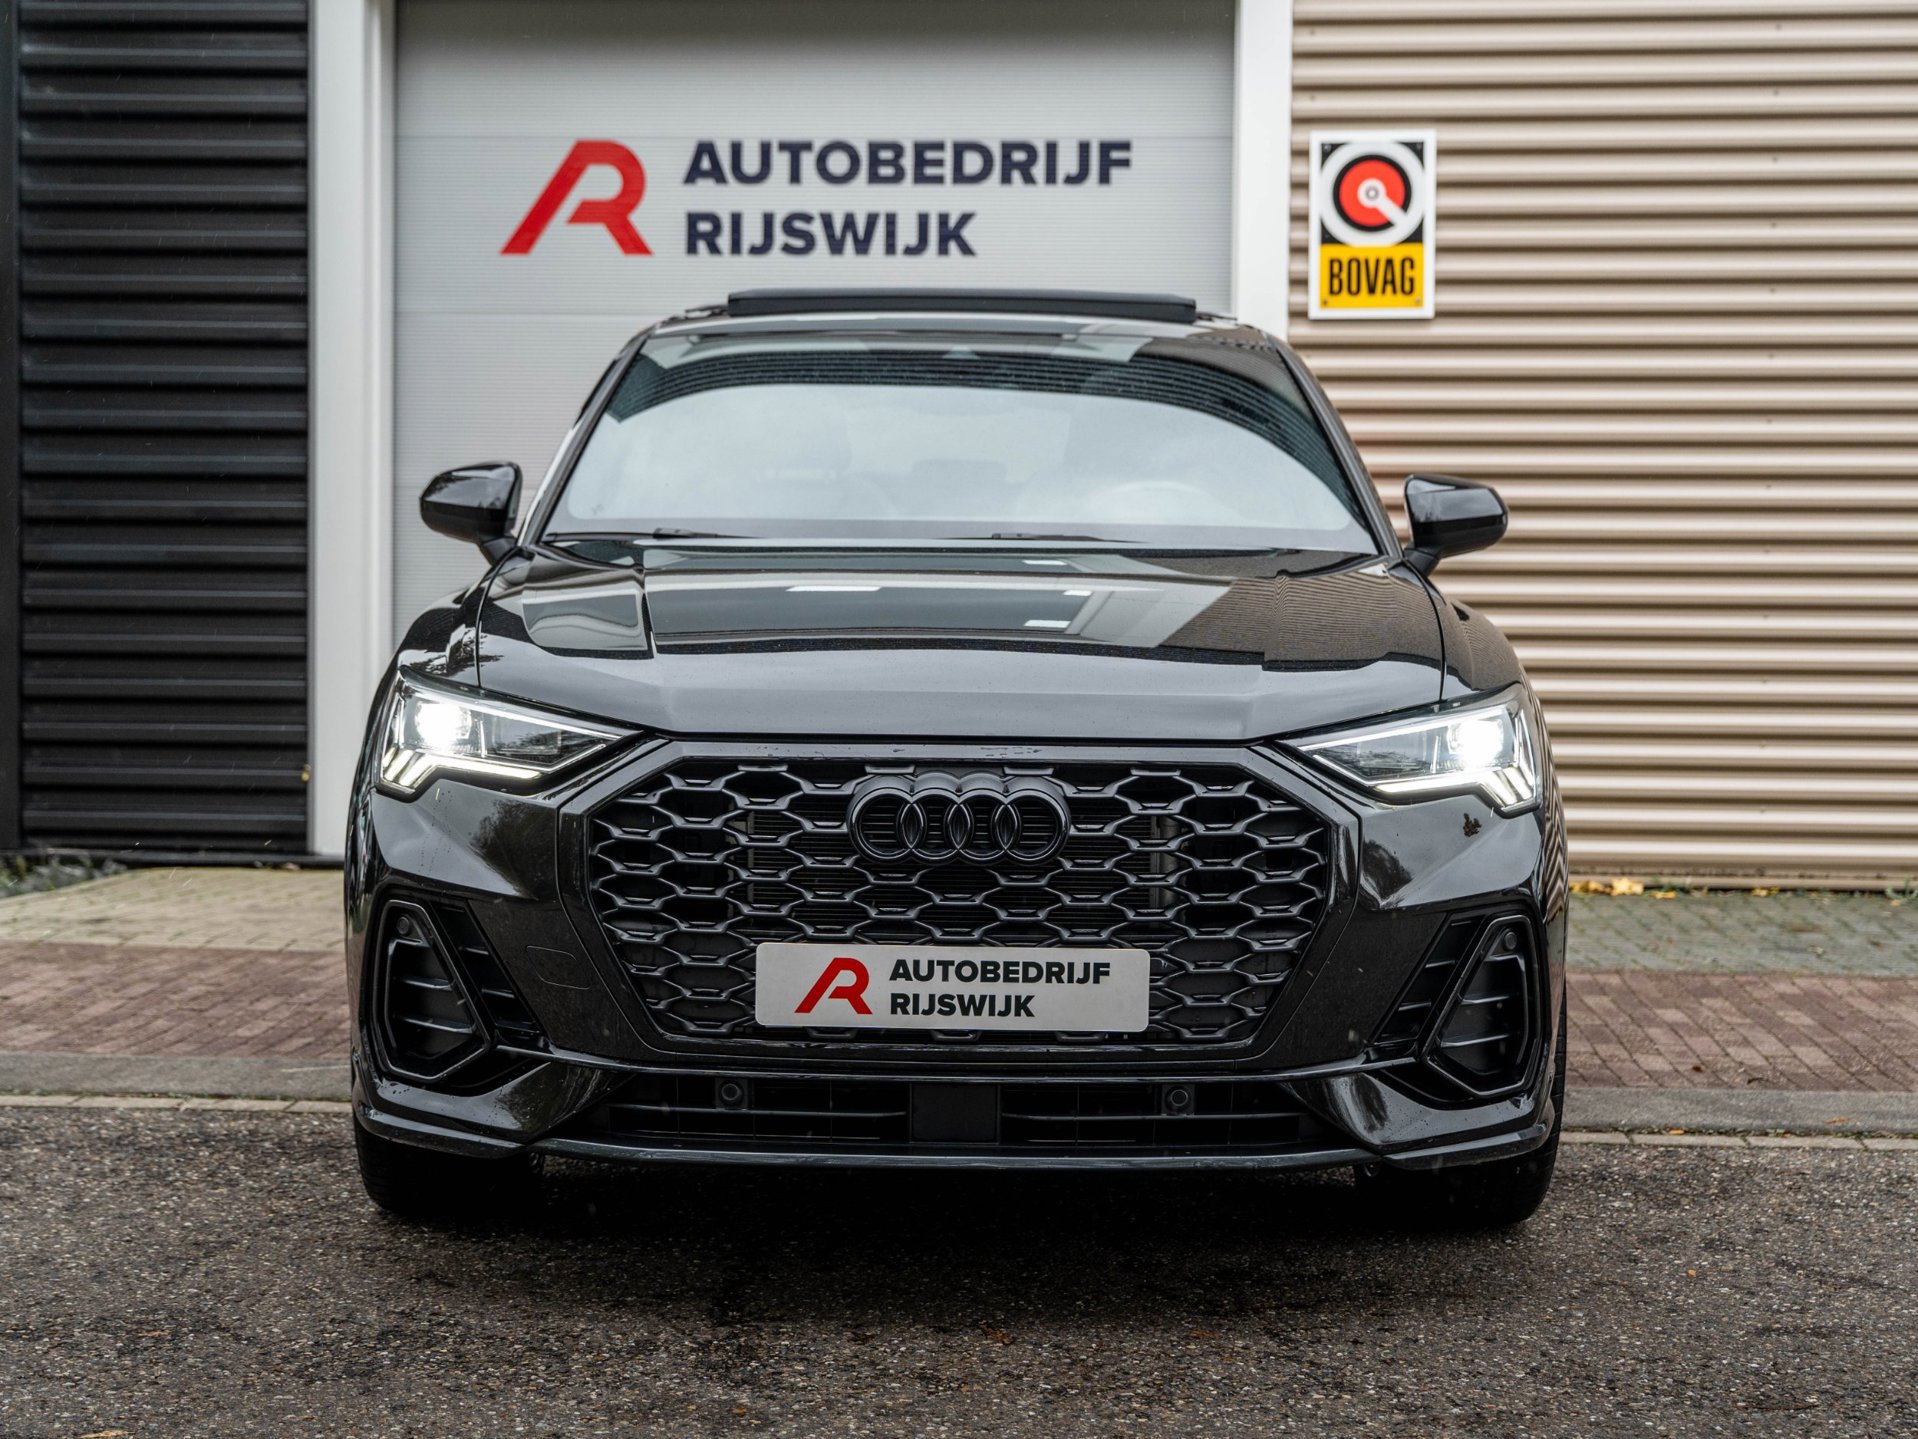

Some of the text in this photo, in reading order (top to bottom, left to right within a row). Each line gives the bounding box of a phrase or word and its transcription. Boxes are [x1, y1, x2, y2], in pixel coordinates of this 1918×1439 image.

[684, 140, 1132, 186] AUTOBEDRIJF
[686, 211, 977, 257] RIJSWIJK
[1329, 257, 1415, 295] BOVAG
[889, 958, 1111, 985] AUTOBEDRIJF
[890, 992, 1036, 1018] RIJSWIJK
